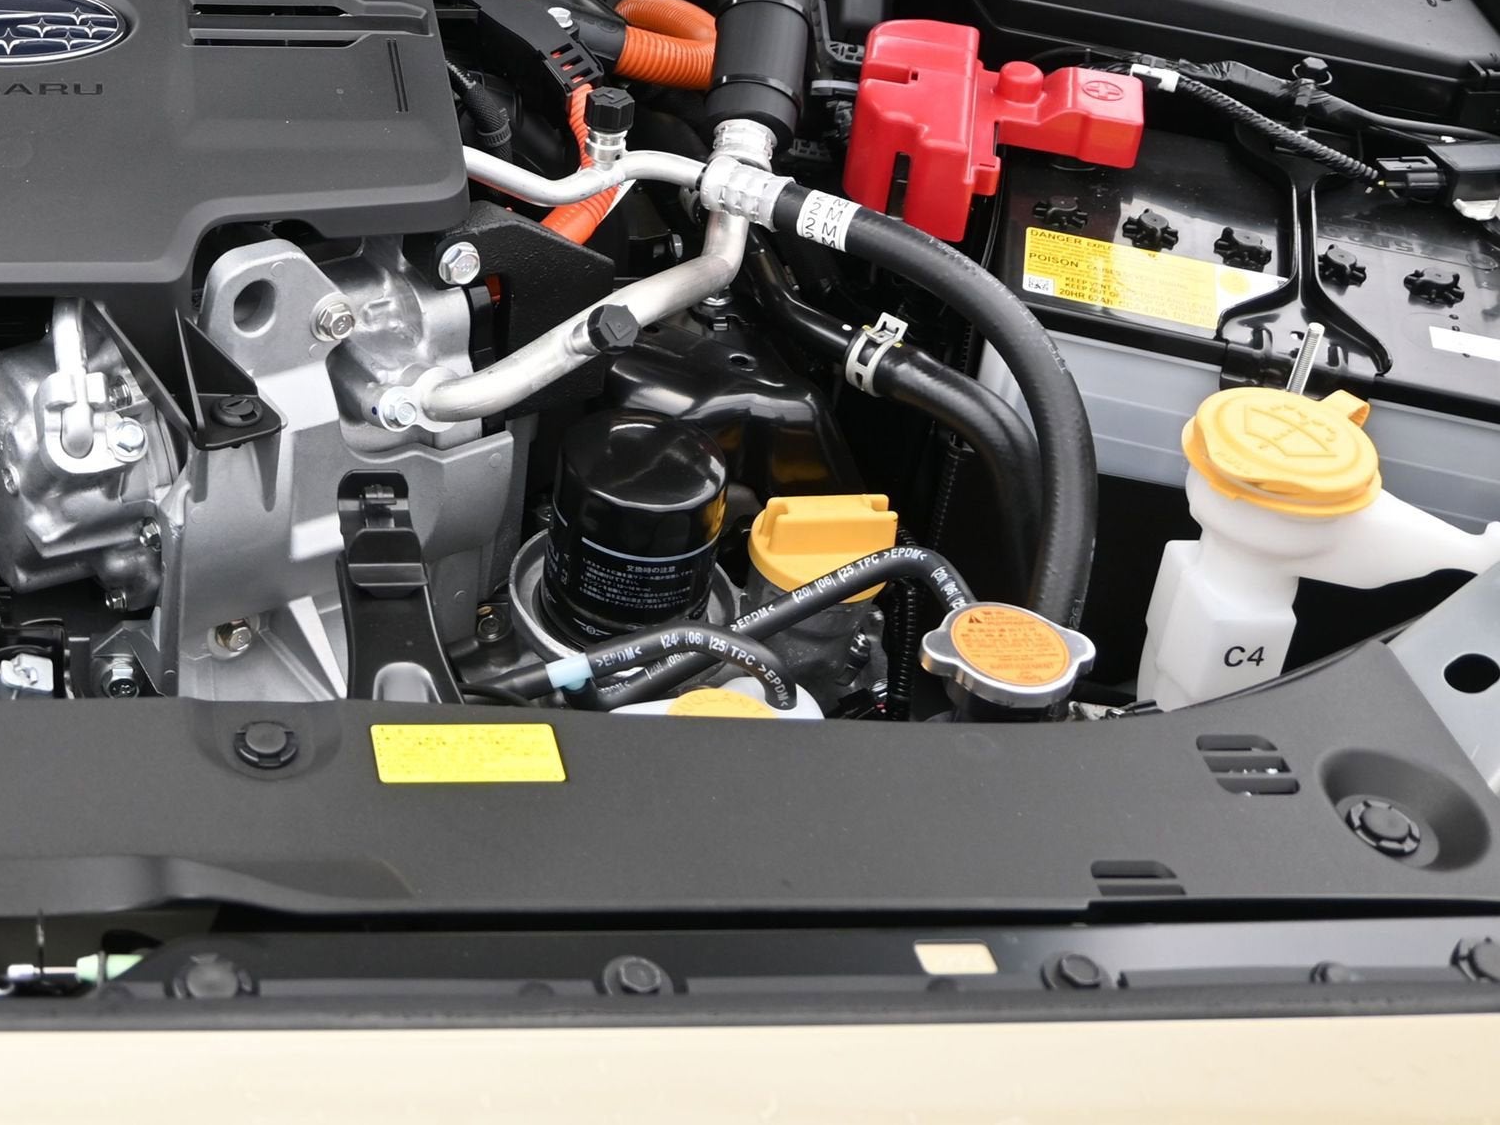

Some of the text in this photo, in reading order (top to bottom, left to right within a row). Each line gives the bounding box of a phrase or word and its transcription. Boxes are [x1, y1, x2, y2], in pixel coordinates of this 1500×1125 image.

[1030, 229, 1083, 246] DANGER
[1028, 252, 1080, 269] POISON
[856, 553, 880, 570] TPC
[730, 645, 756, 666] TPC
[1224, 645, 1265, 667] C4
